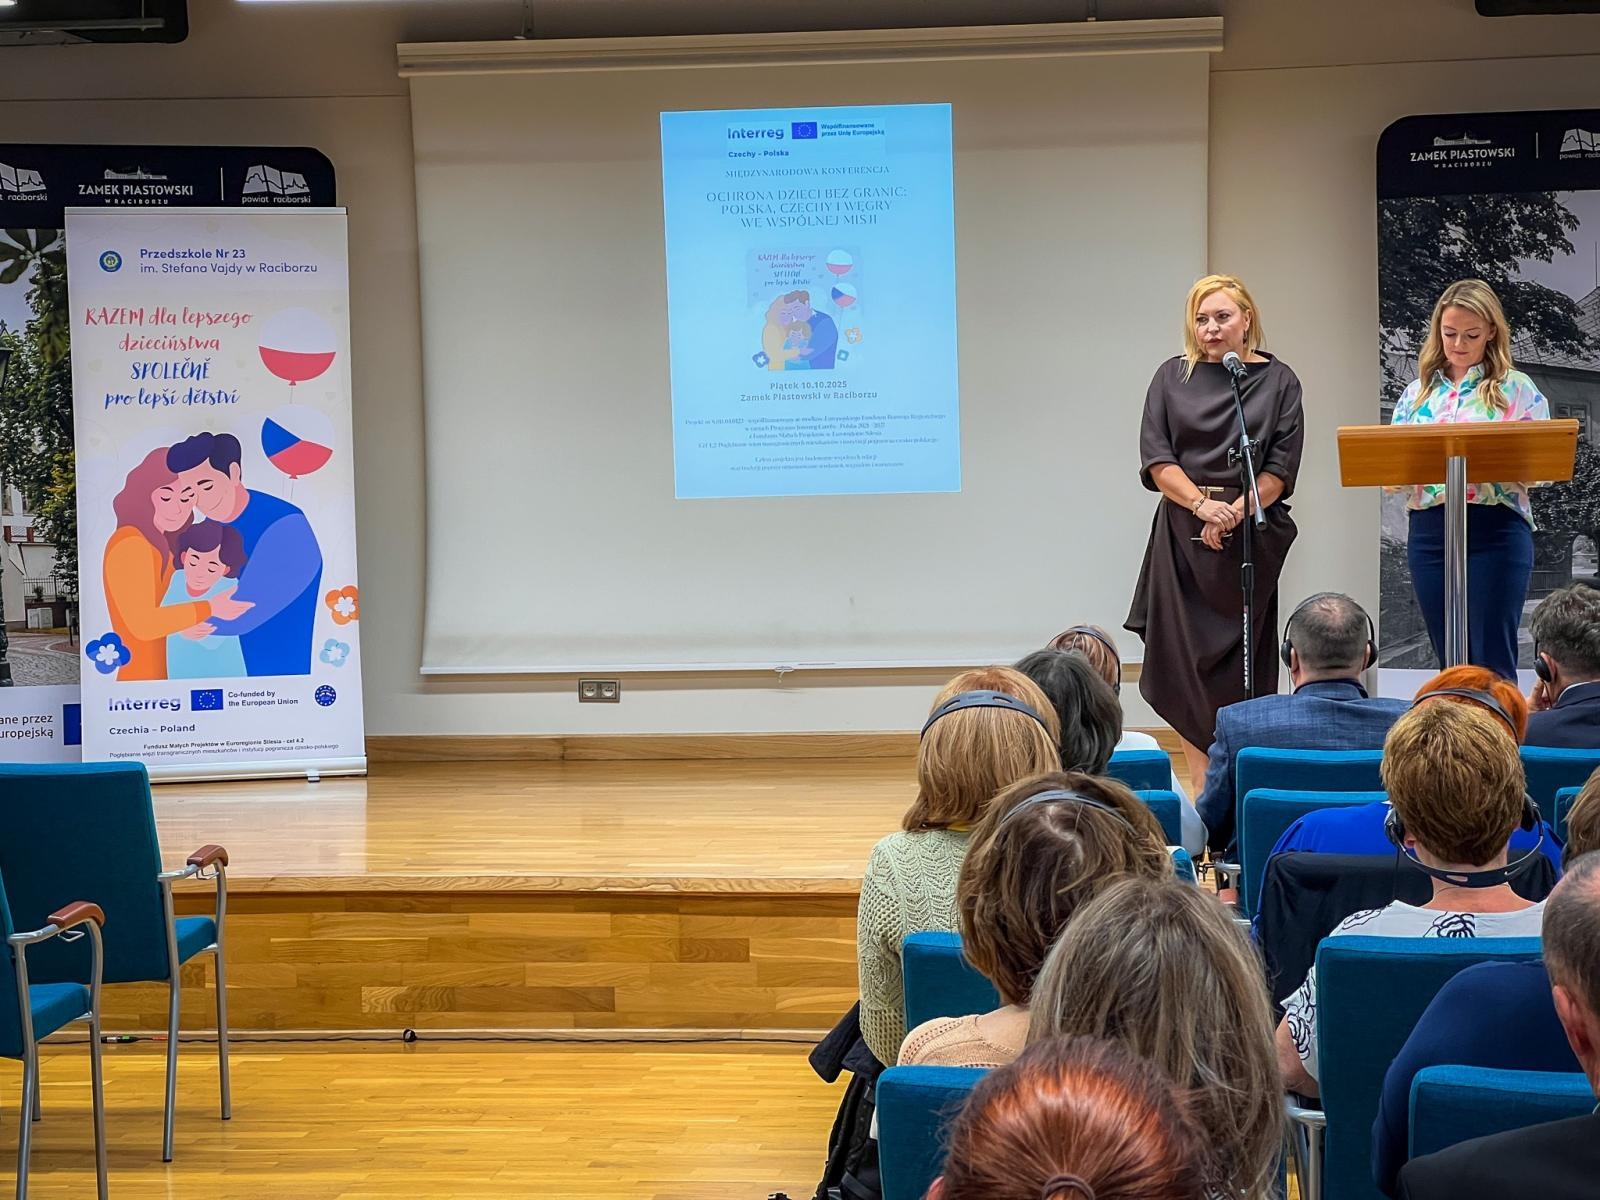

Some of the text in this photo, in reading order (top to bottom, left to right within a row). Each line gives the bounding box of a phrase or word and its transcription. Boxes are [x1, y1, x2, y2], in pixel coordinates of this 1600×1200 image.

[727, 127, 785, 140] Interreg
[728, 151, 756, 159] Czechy
[763, 149, 790, 157] Polska
[1410, 148, 1515, 162] ZAMEK PIASTOWSKI
[725, 165, 890, 178] MIĘDZYNARODOWA KONFERENCJA
[78, 184, 193, 196] ZAMEK PIASTOWSKI
[706, 186, 908, 202] OCHRONA DZIECI BEZ GRANIC:
[7, 193, 48, 201] raciborski
[242, 195, 311, 205] powiat raciborski
[721, 203, 776, 215] POLSKA,
[780, 201, 833, 214] CZECHY
[844, 200, 892, 213] WĘGRY
[740, 213, 877, 229] WE WSPÓLNEJ MISJI
[139, 248, 246, 259] Przedszkole Nr 23
[139, 262, 318, 275] im. Stefana Vajdy w Raciborzu
[148, 306, 177, 326] dla
[182, 306, 255, 328] lepszego
[118, 333, 221, 351] dzieciństwa
[130, 357, 211, 381] SPOLEČNĚ
[770, 380, 848, 391] Piątek 10.10.2025
[104, 387, 241, 410] pro lepší dětství
[740, 394, 771, 402] Zamek
[773, 392, 821, 401] Piastowski
[833, 391, 878, 399] Raciborzu
[228, 690, 276, 698] Co-funded by
[108, 697, 182, 712] Interreg
[22, 715, 54, 726] przez
[109, 725, 150, 735] Czechia
[160, 723, 196, 733] Poland
